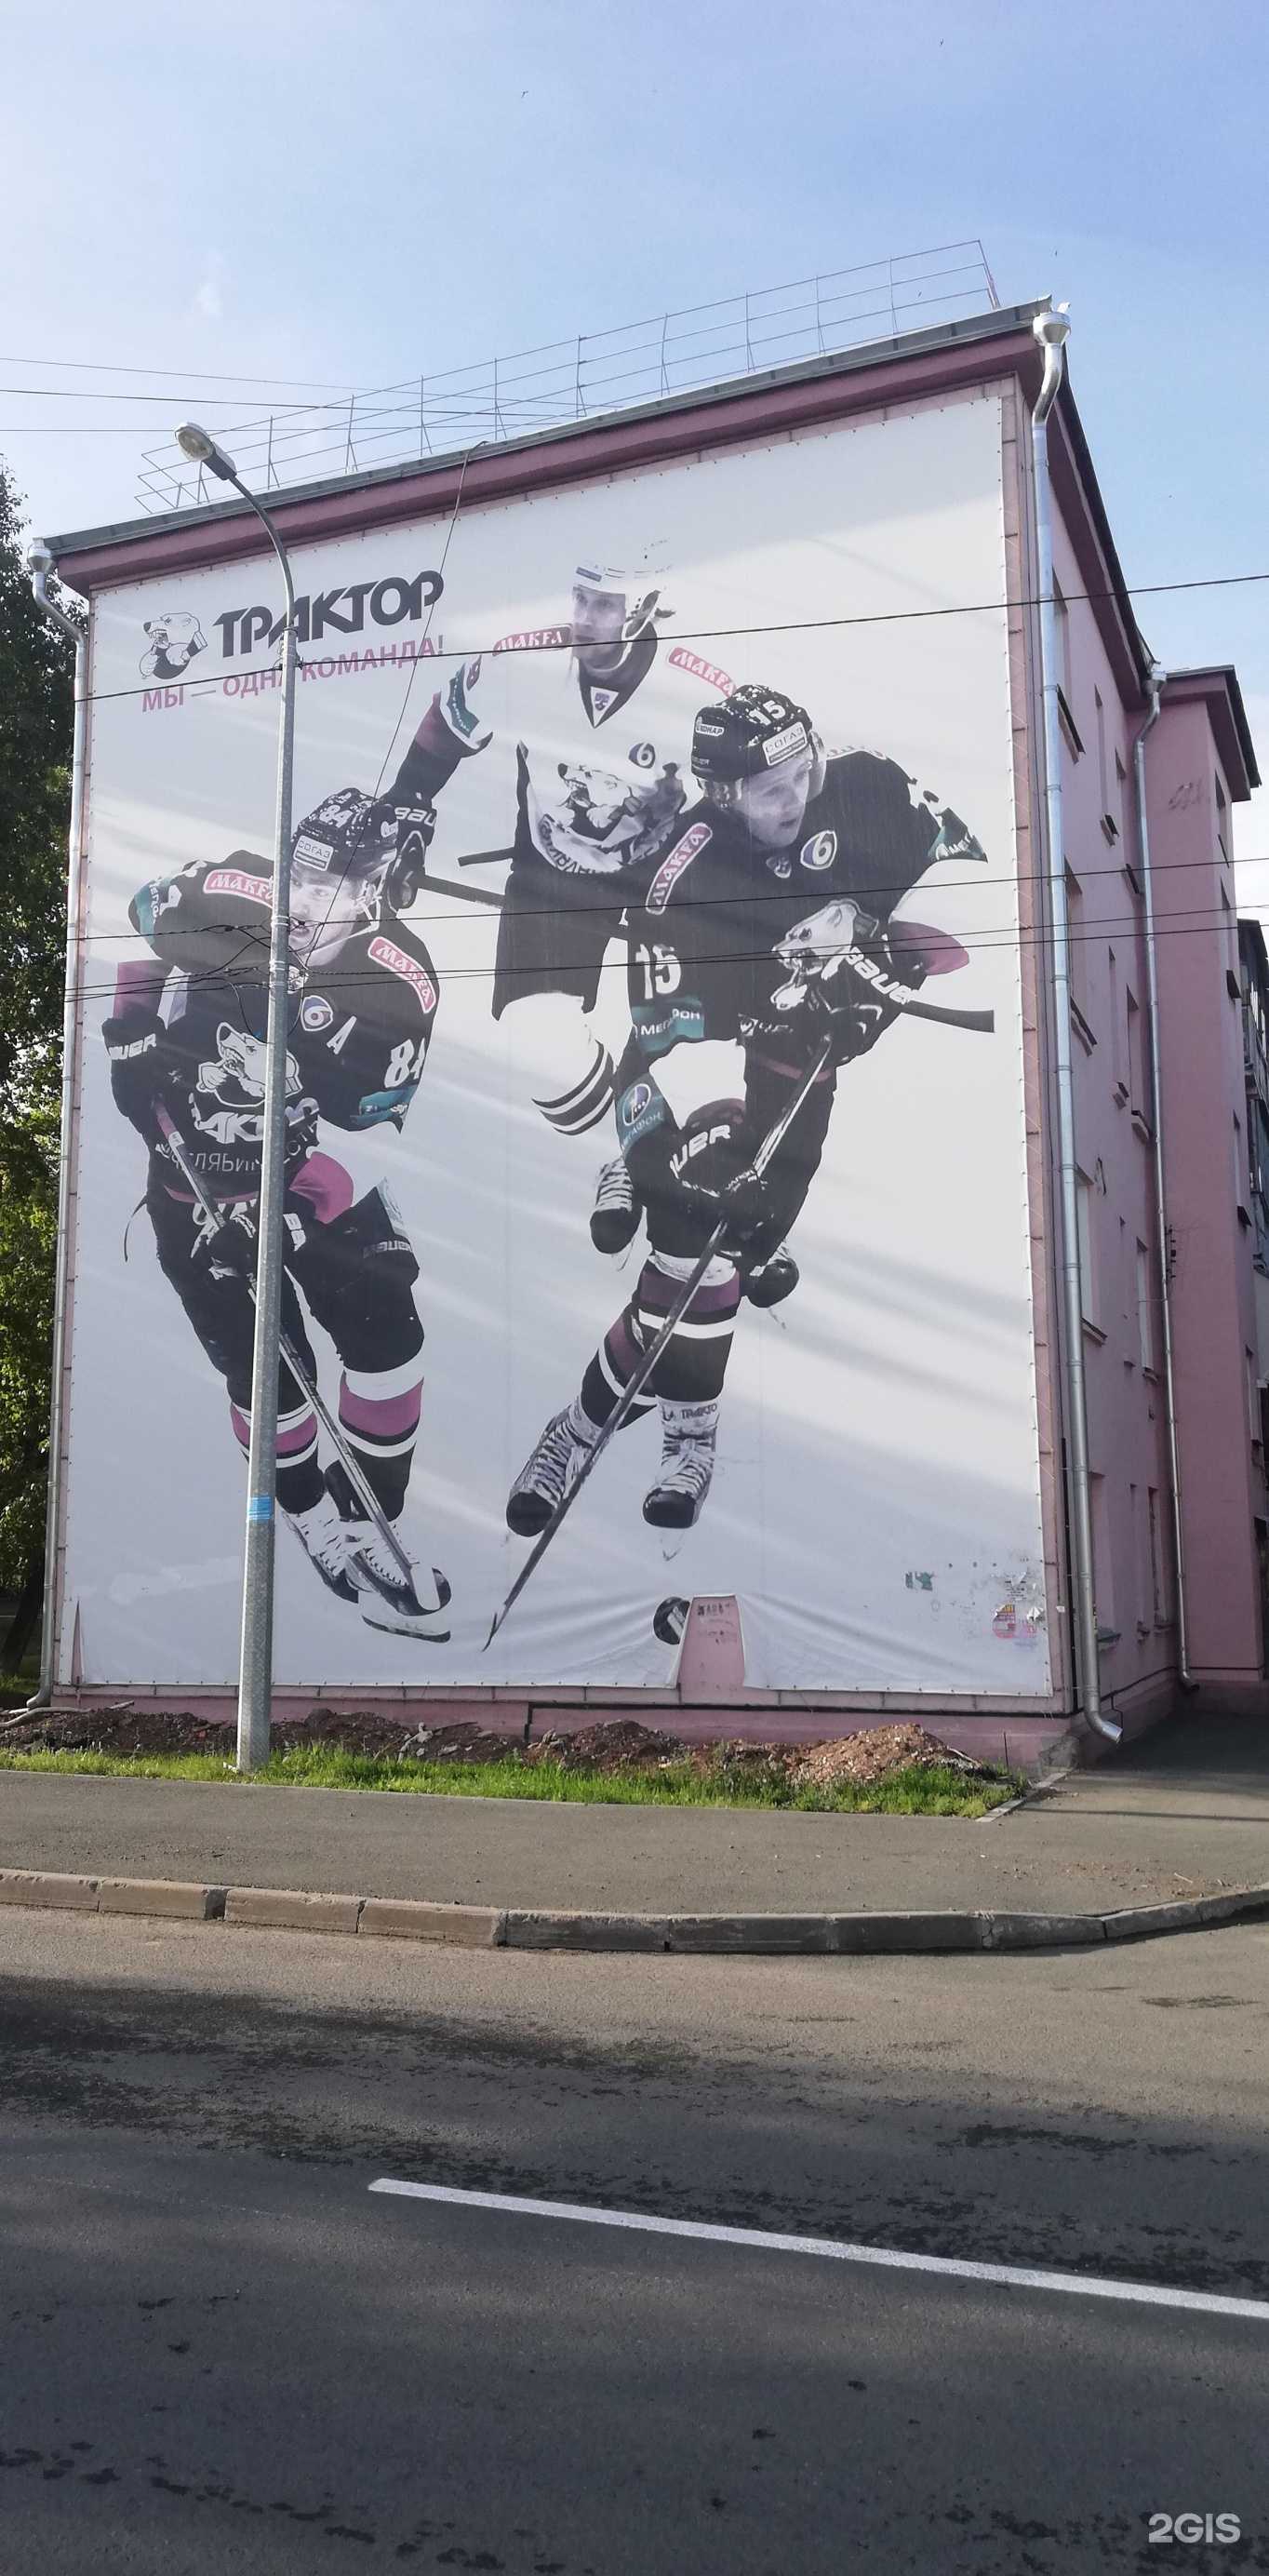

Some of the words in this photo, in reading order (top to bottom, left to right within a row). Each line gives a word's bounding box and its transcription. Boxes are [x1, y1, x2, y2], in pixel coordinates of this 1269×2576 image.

[212, 570, 445, 659] ТРАКТОР
[141, 686, 184, 712] МЫ
[221, 665, 285, 699] ОДН
[301, 634, 444, 681] КОМАНДА!
[748, 700, 786, 726] 15
[319, 804, 354, 829] 84
[635, 944, 682, 1000] 15
